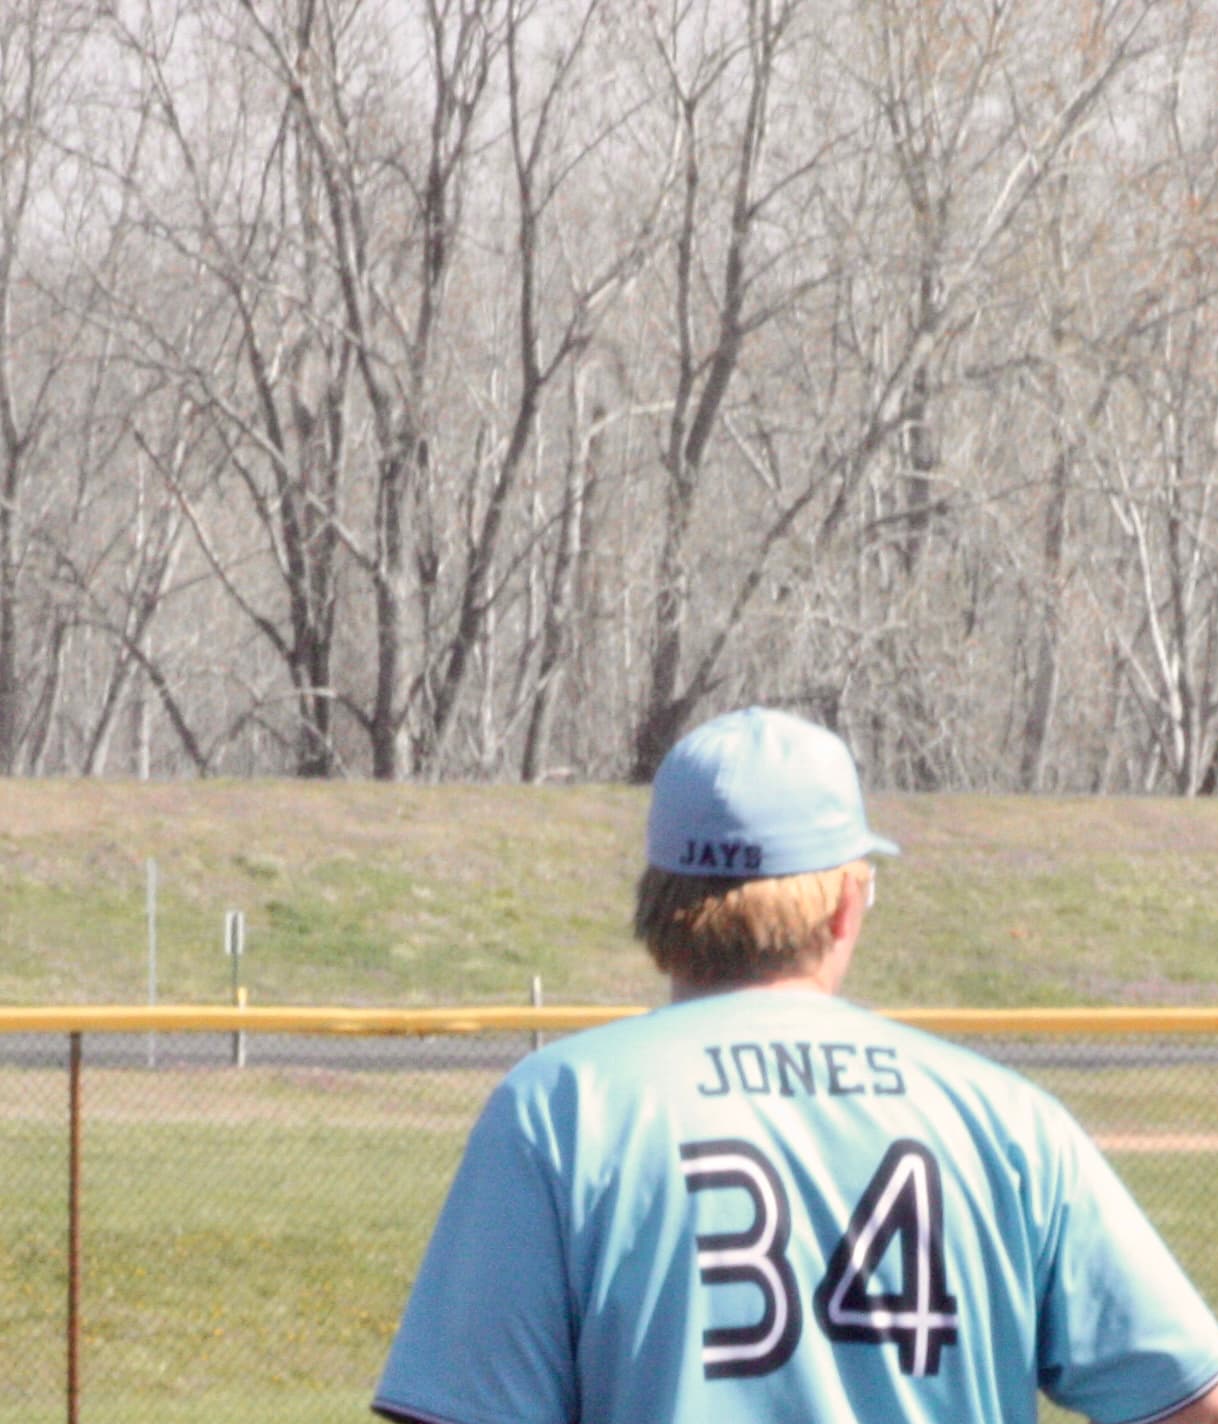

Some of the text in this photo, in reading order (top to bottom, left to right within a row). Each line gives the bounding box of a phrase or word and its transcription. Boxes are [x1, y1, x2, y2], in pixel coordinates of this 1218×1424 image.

[679, 838, 763, 869] JAYS
[697, 1041, 907, 1097] JONES
[678, 1137, 959, 1381] 34
